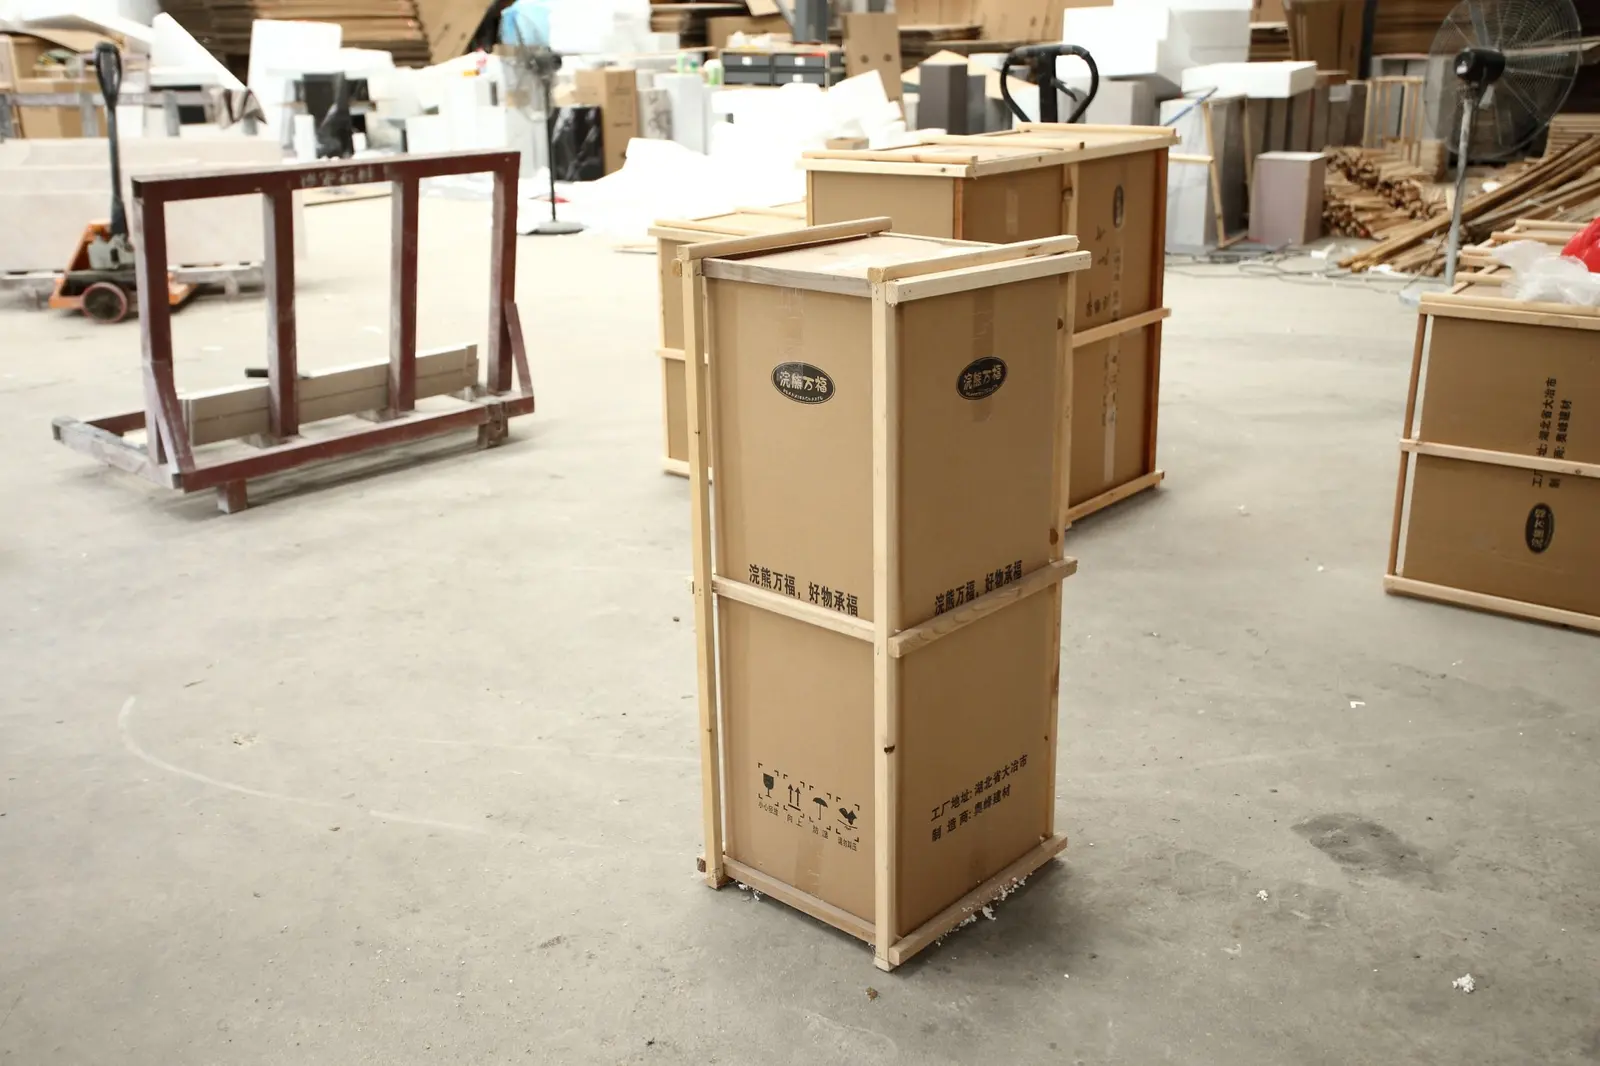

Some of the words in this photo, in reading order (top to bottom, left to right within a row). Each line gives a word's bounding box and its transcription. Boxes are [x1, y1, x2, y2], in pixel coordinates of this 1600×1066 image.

[780, 371, 828, 393] 浣熊万福
[963, 364, 1002, 391] 浣熊万福
[1532, 377, 1557, 488] 工厂址：湖北省大冶市
[748, 563, 859, 617] 浣熊万福，好物承福
